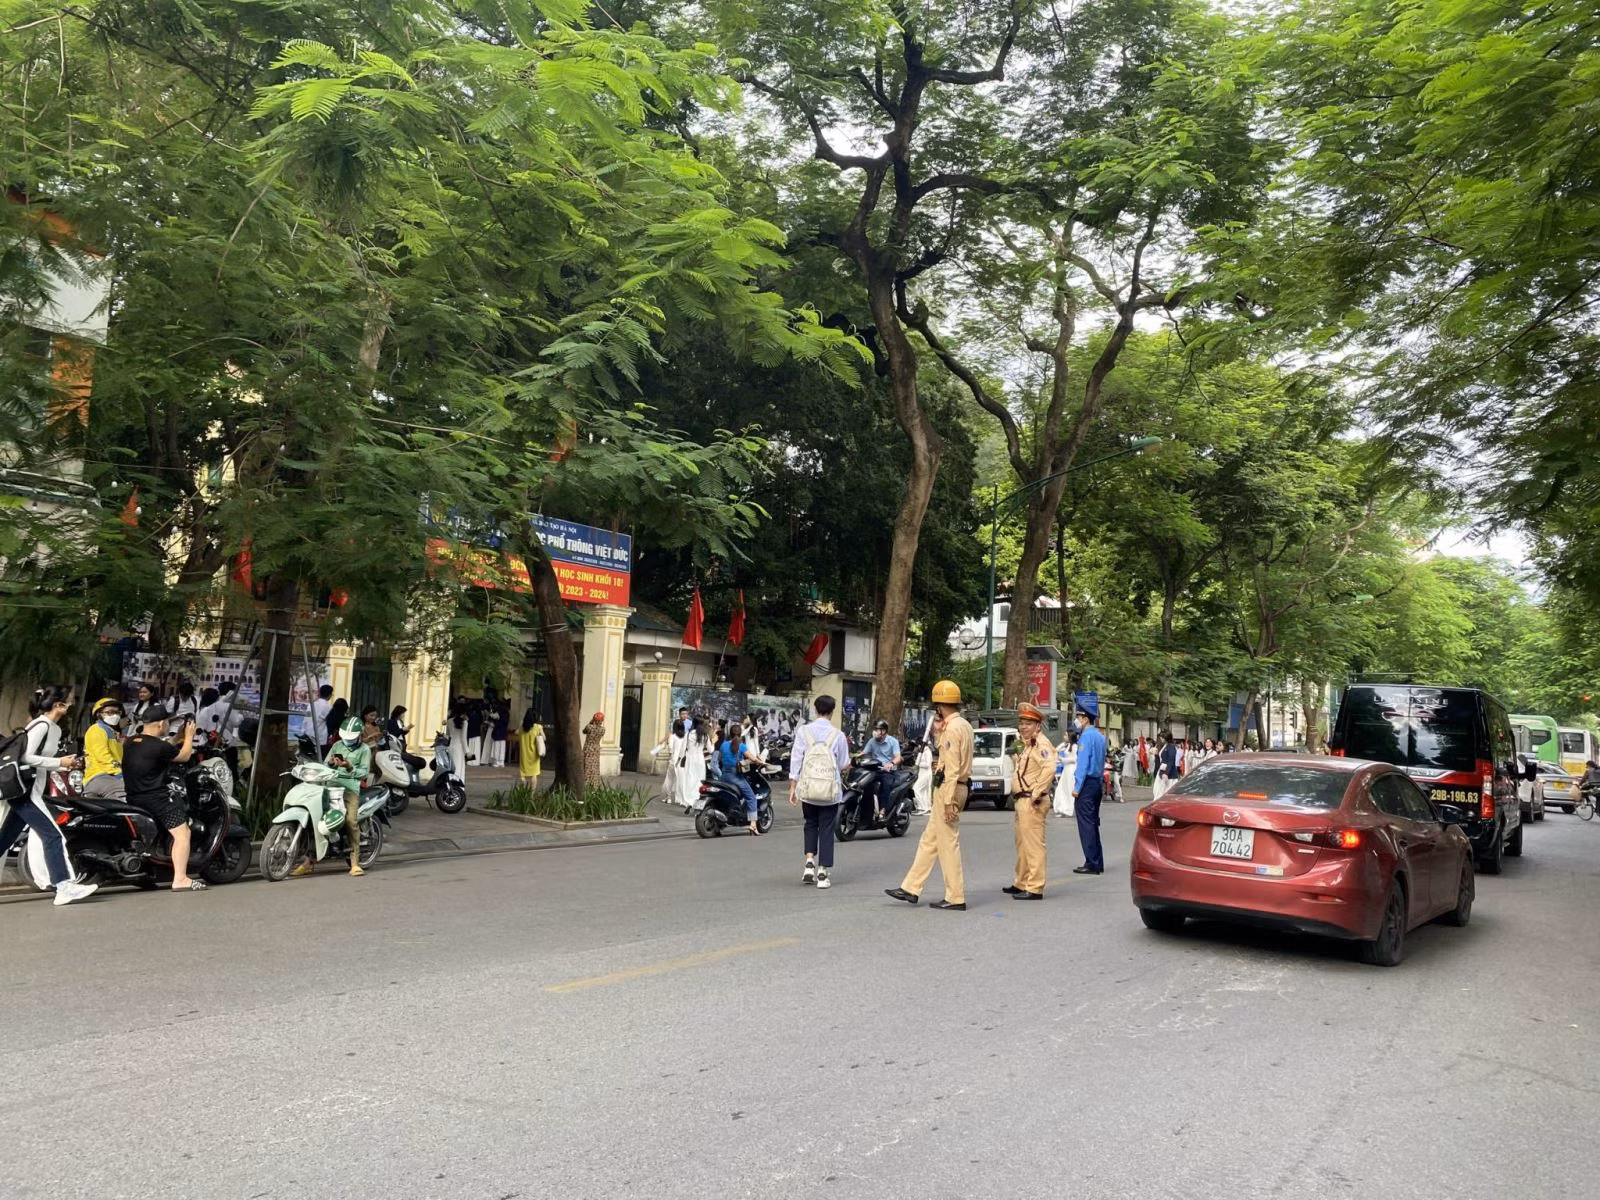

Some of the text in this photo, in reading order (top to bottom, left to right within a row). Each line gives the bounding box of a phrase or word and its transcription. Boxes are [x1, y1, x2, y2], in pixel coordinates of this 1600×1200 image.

[547, 533, 565, 549] PHỔ
[566, 538, 593, 555] THÔNG
[595, 543, 612, 560] VIỆT
[613, 546, 628, 562] ĐỨC
[560, 567, 575, 581] HỌC
[576, 570, 594, 583] SINH
[595, 573, 611, 586] KHỐI
[613, 577, 624, 587] 10!
[565, 585, 583, 596] 2023
[589, 588, 609, 600] 2024!
[1431, 789, 1479, 803] 29B-196.63
[1222, 828, 1243, 842] 30A
[1212, 841, 1251, 857] 704.42
